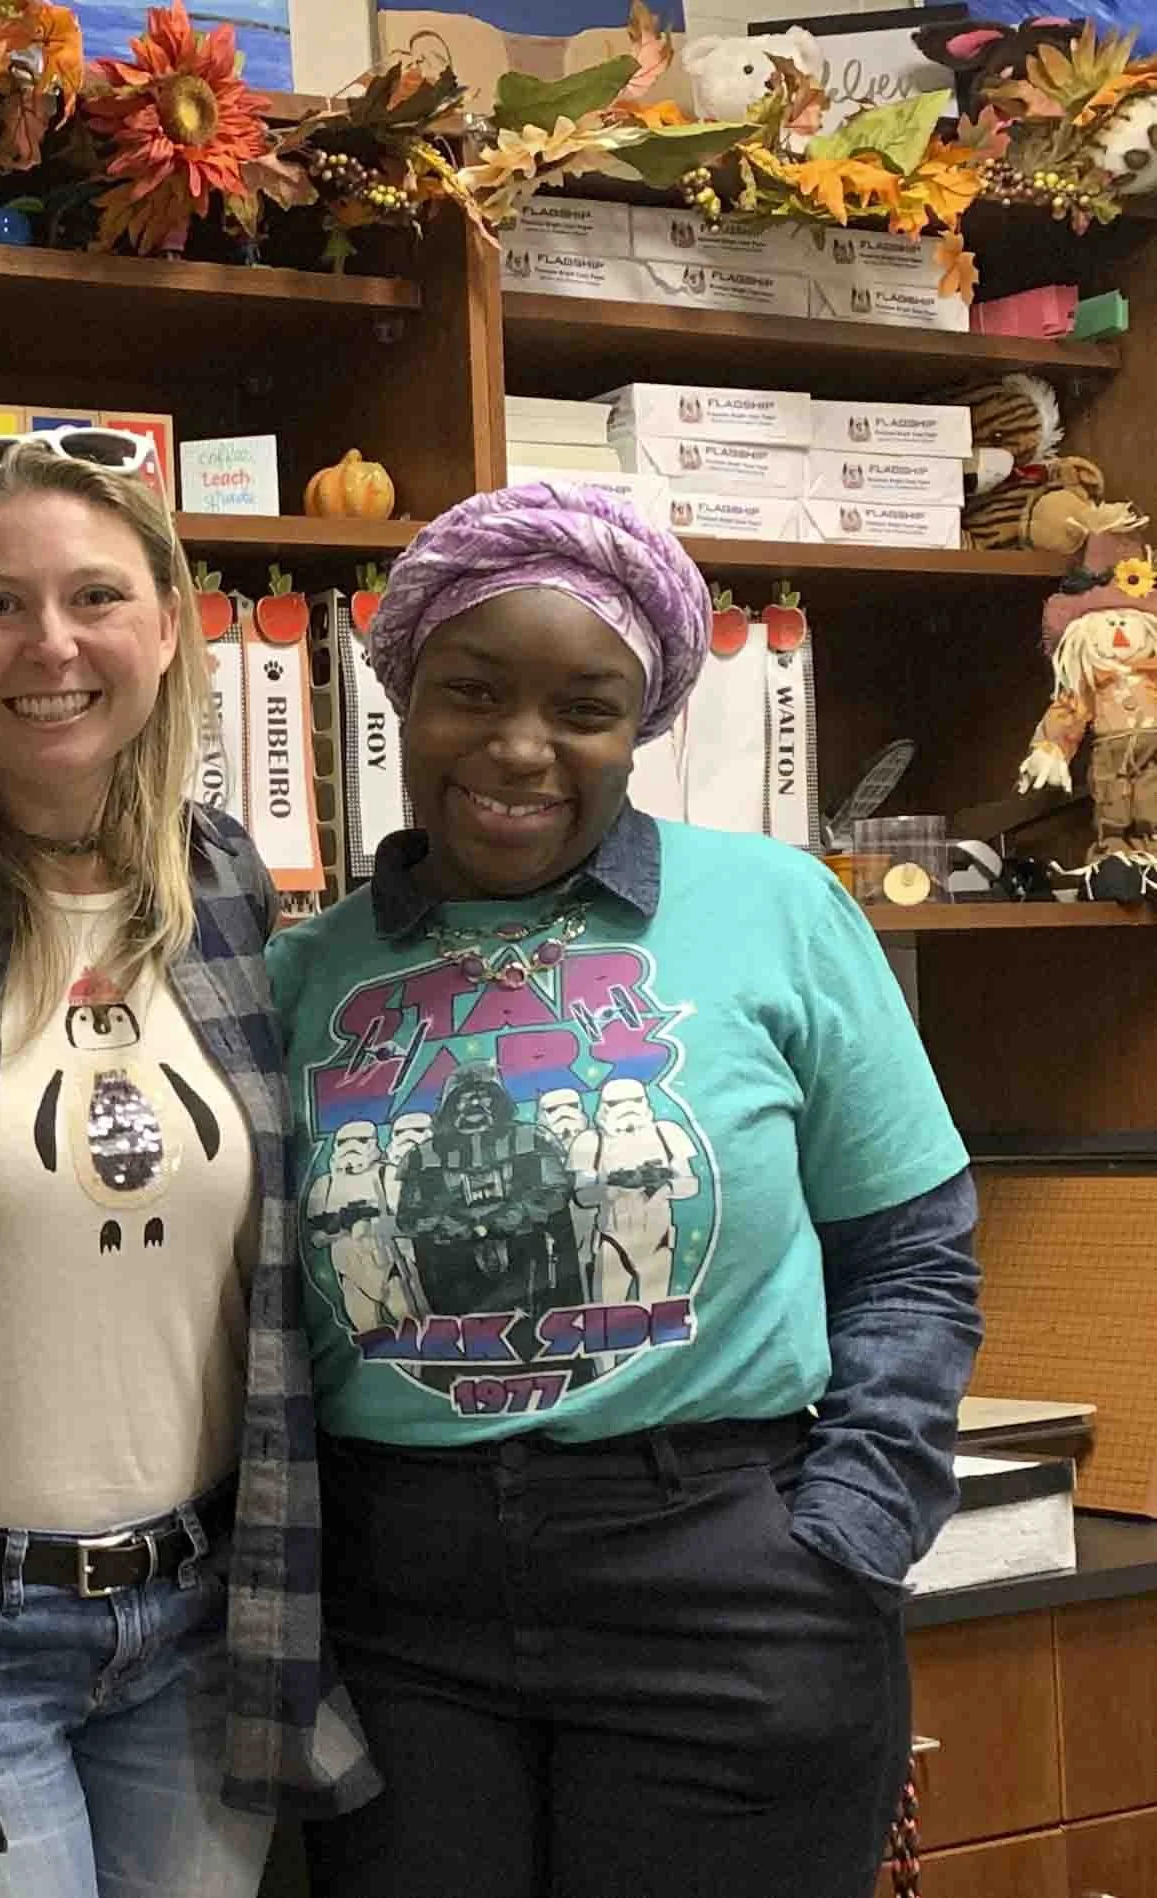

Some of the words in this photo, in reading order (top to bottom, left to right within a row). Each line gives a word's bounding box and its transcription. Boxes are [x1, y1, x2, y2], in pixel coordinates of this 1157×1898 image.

[537, 253, 604, 270] FLAGSHIP
[707, 399, 776, 412] FLAGSHIP
[874, 416, 938, 428] FLAGSHIP
[705, 446, 769, 460] FLAGSHIP
[869, 463, 929, 476] FLAGSHIP
[698, 502, 761, 516] FLAGSHIP
[865, 505, 926, 520] FLAGSHIP
[366, 711, 386, 771] ROY
[776, 686, 795, 796] WALTON
[266, 696, 291, 818] RIBEIRO
[538, 1298, 693, 1358] SIDE
[453, 1374, 568, 1415] 1977
